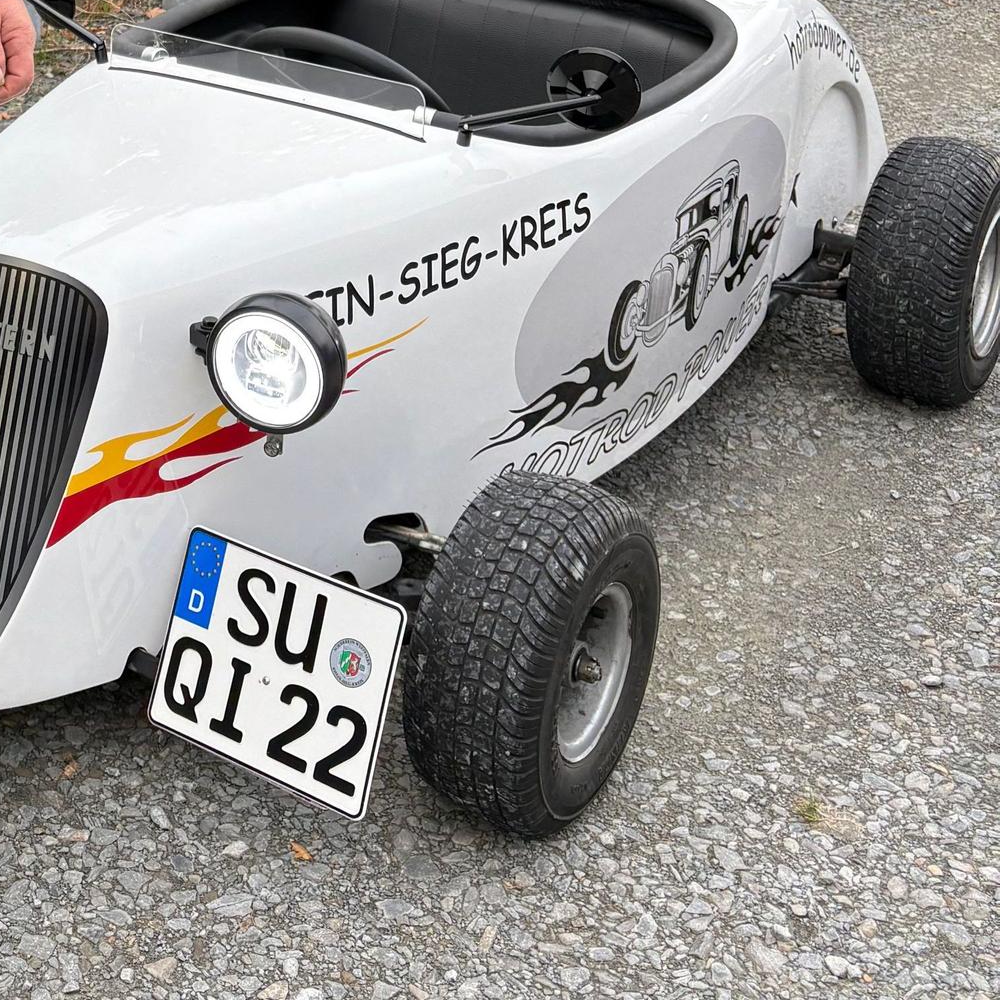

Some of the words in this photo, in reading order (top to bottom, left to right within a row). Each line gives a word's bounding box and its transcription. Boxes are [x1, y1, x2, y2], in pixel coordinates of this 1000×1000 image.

[783, 9, 861, 83] hotrodpower.de
[187, 588, 206, 613] D
[227, 568, 328, 674] SU
[164, 636, 252, 744] QI
[266, 683, 368, 797] 22
